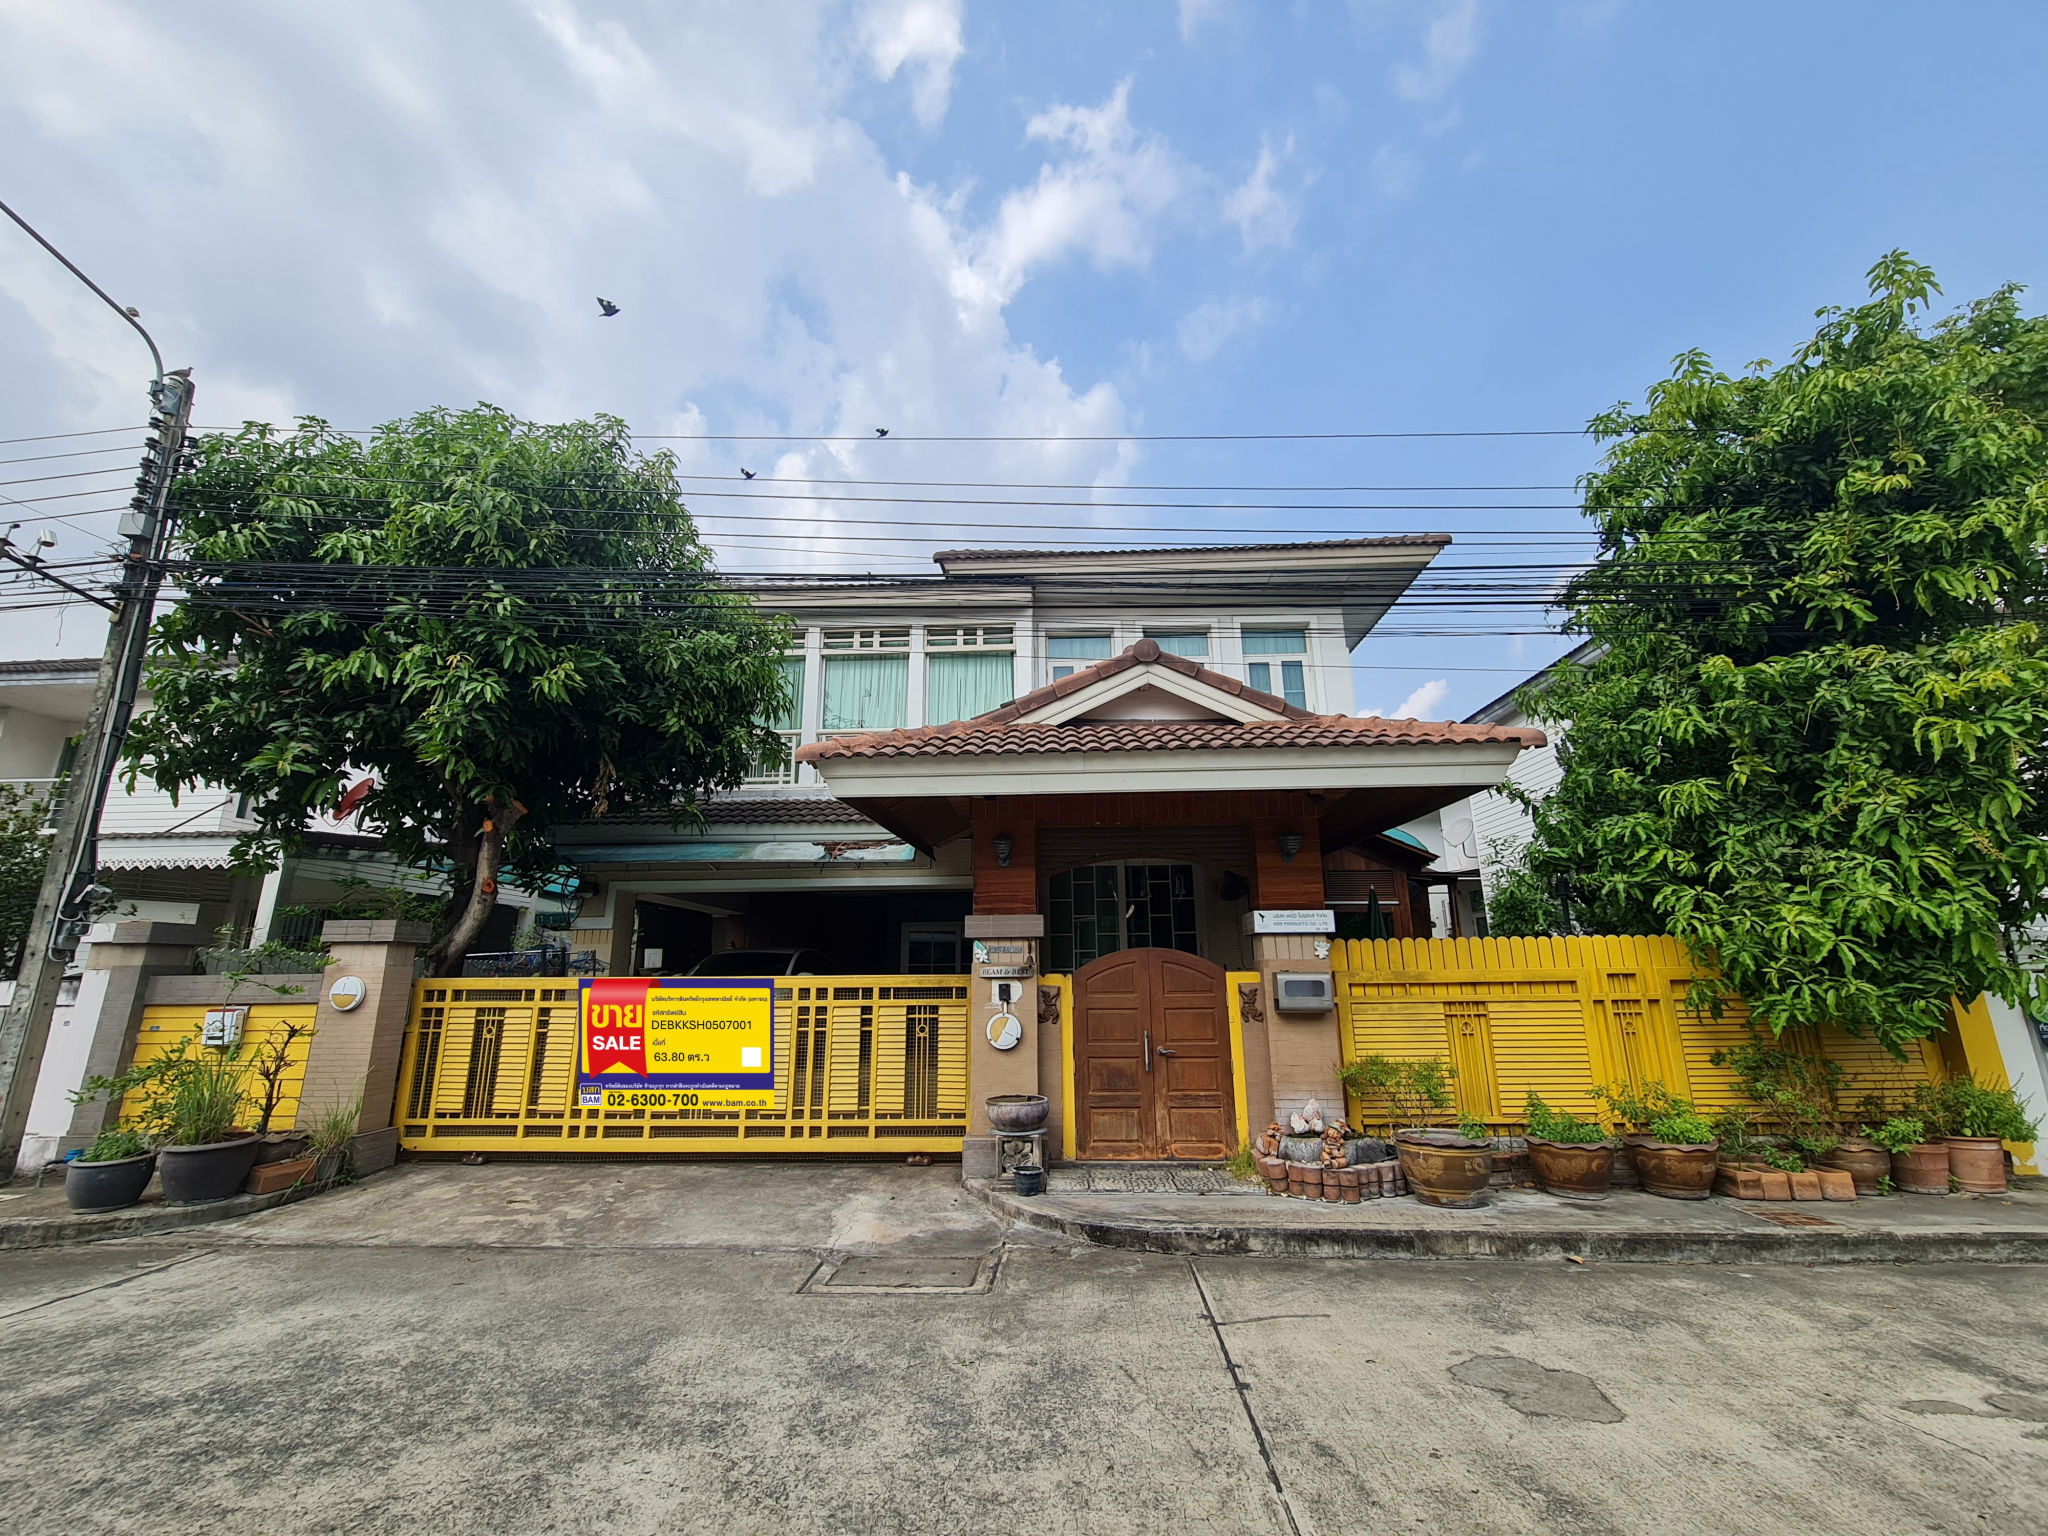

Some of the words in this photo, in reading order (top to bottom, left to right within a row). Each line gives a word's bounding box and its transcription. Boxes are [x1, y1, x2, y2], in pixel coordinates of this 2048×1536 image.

[591, 1004, 643, 1028] ขาย
[651, 1020, 752, 1030] DEBKKSH0507001
[592, 1035, 641, 1051] SALE
[653, 1052, 685, 1062] 63.80
[687, 1054, 710, 1062] ตร.ว
[582, 1086, 601, 1094] บสก
[582, 1096, 600, 1104] BAM
[607, 1093, 699, 1107] 02-6300-700
[702, 1099, 767, 1107] www.bam.co.th
